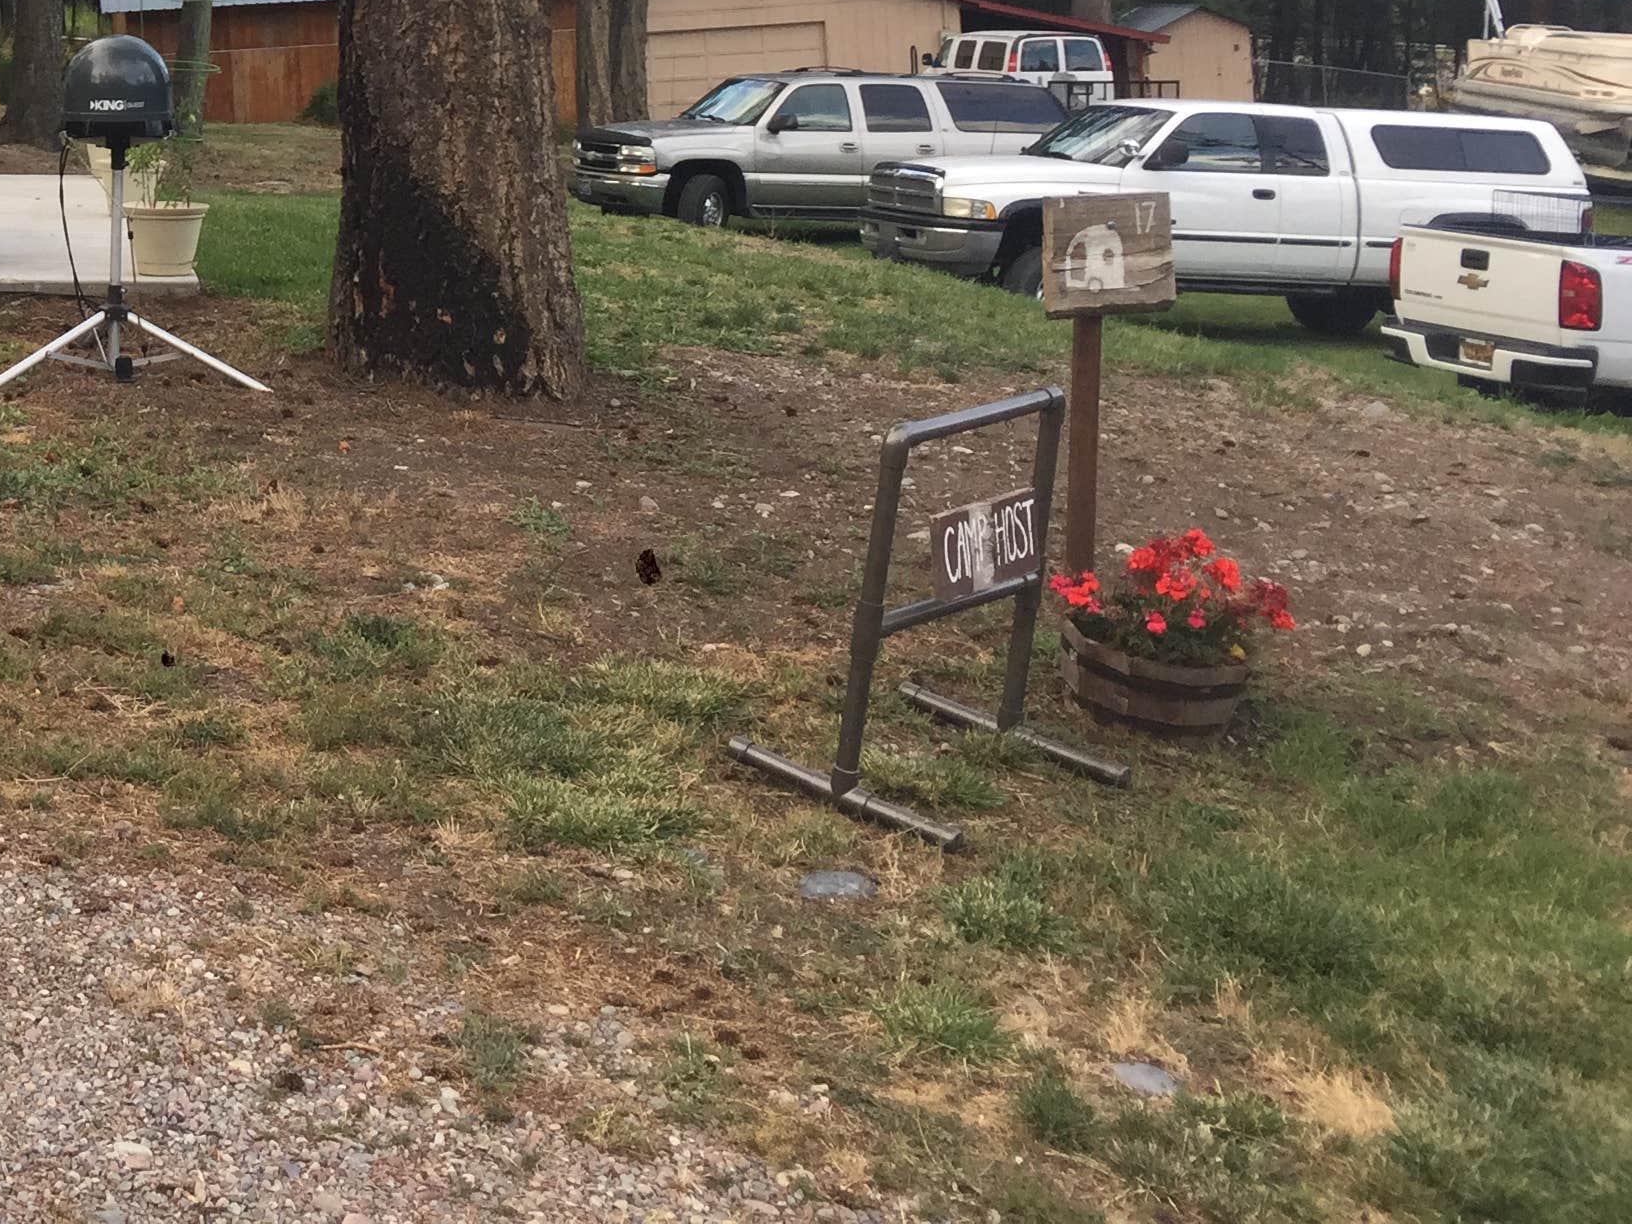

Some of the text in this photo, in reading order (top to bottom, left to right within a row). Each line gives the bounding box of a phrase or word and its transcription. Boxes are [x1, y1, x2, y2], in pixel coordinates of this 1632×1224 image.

[94, 100, 124, 111] KING
[1135, 201, 1156, 234] 17
[944, 498, 1035, 583] CAMP HOST
